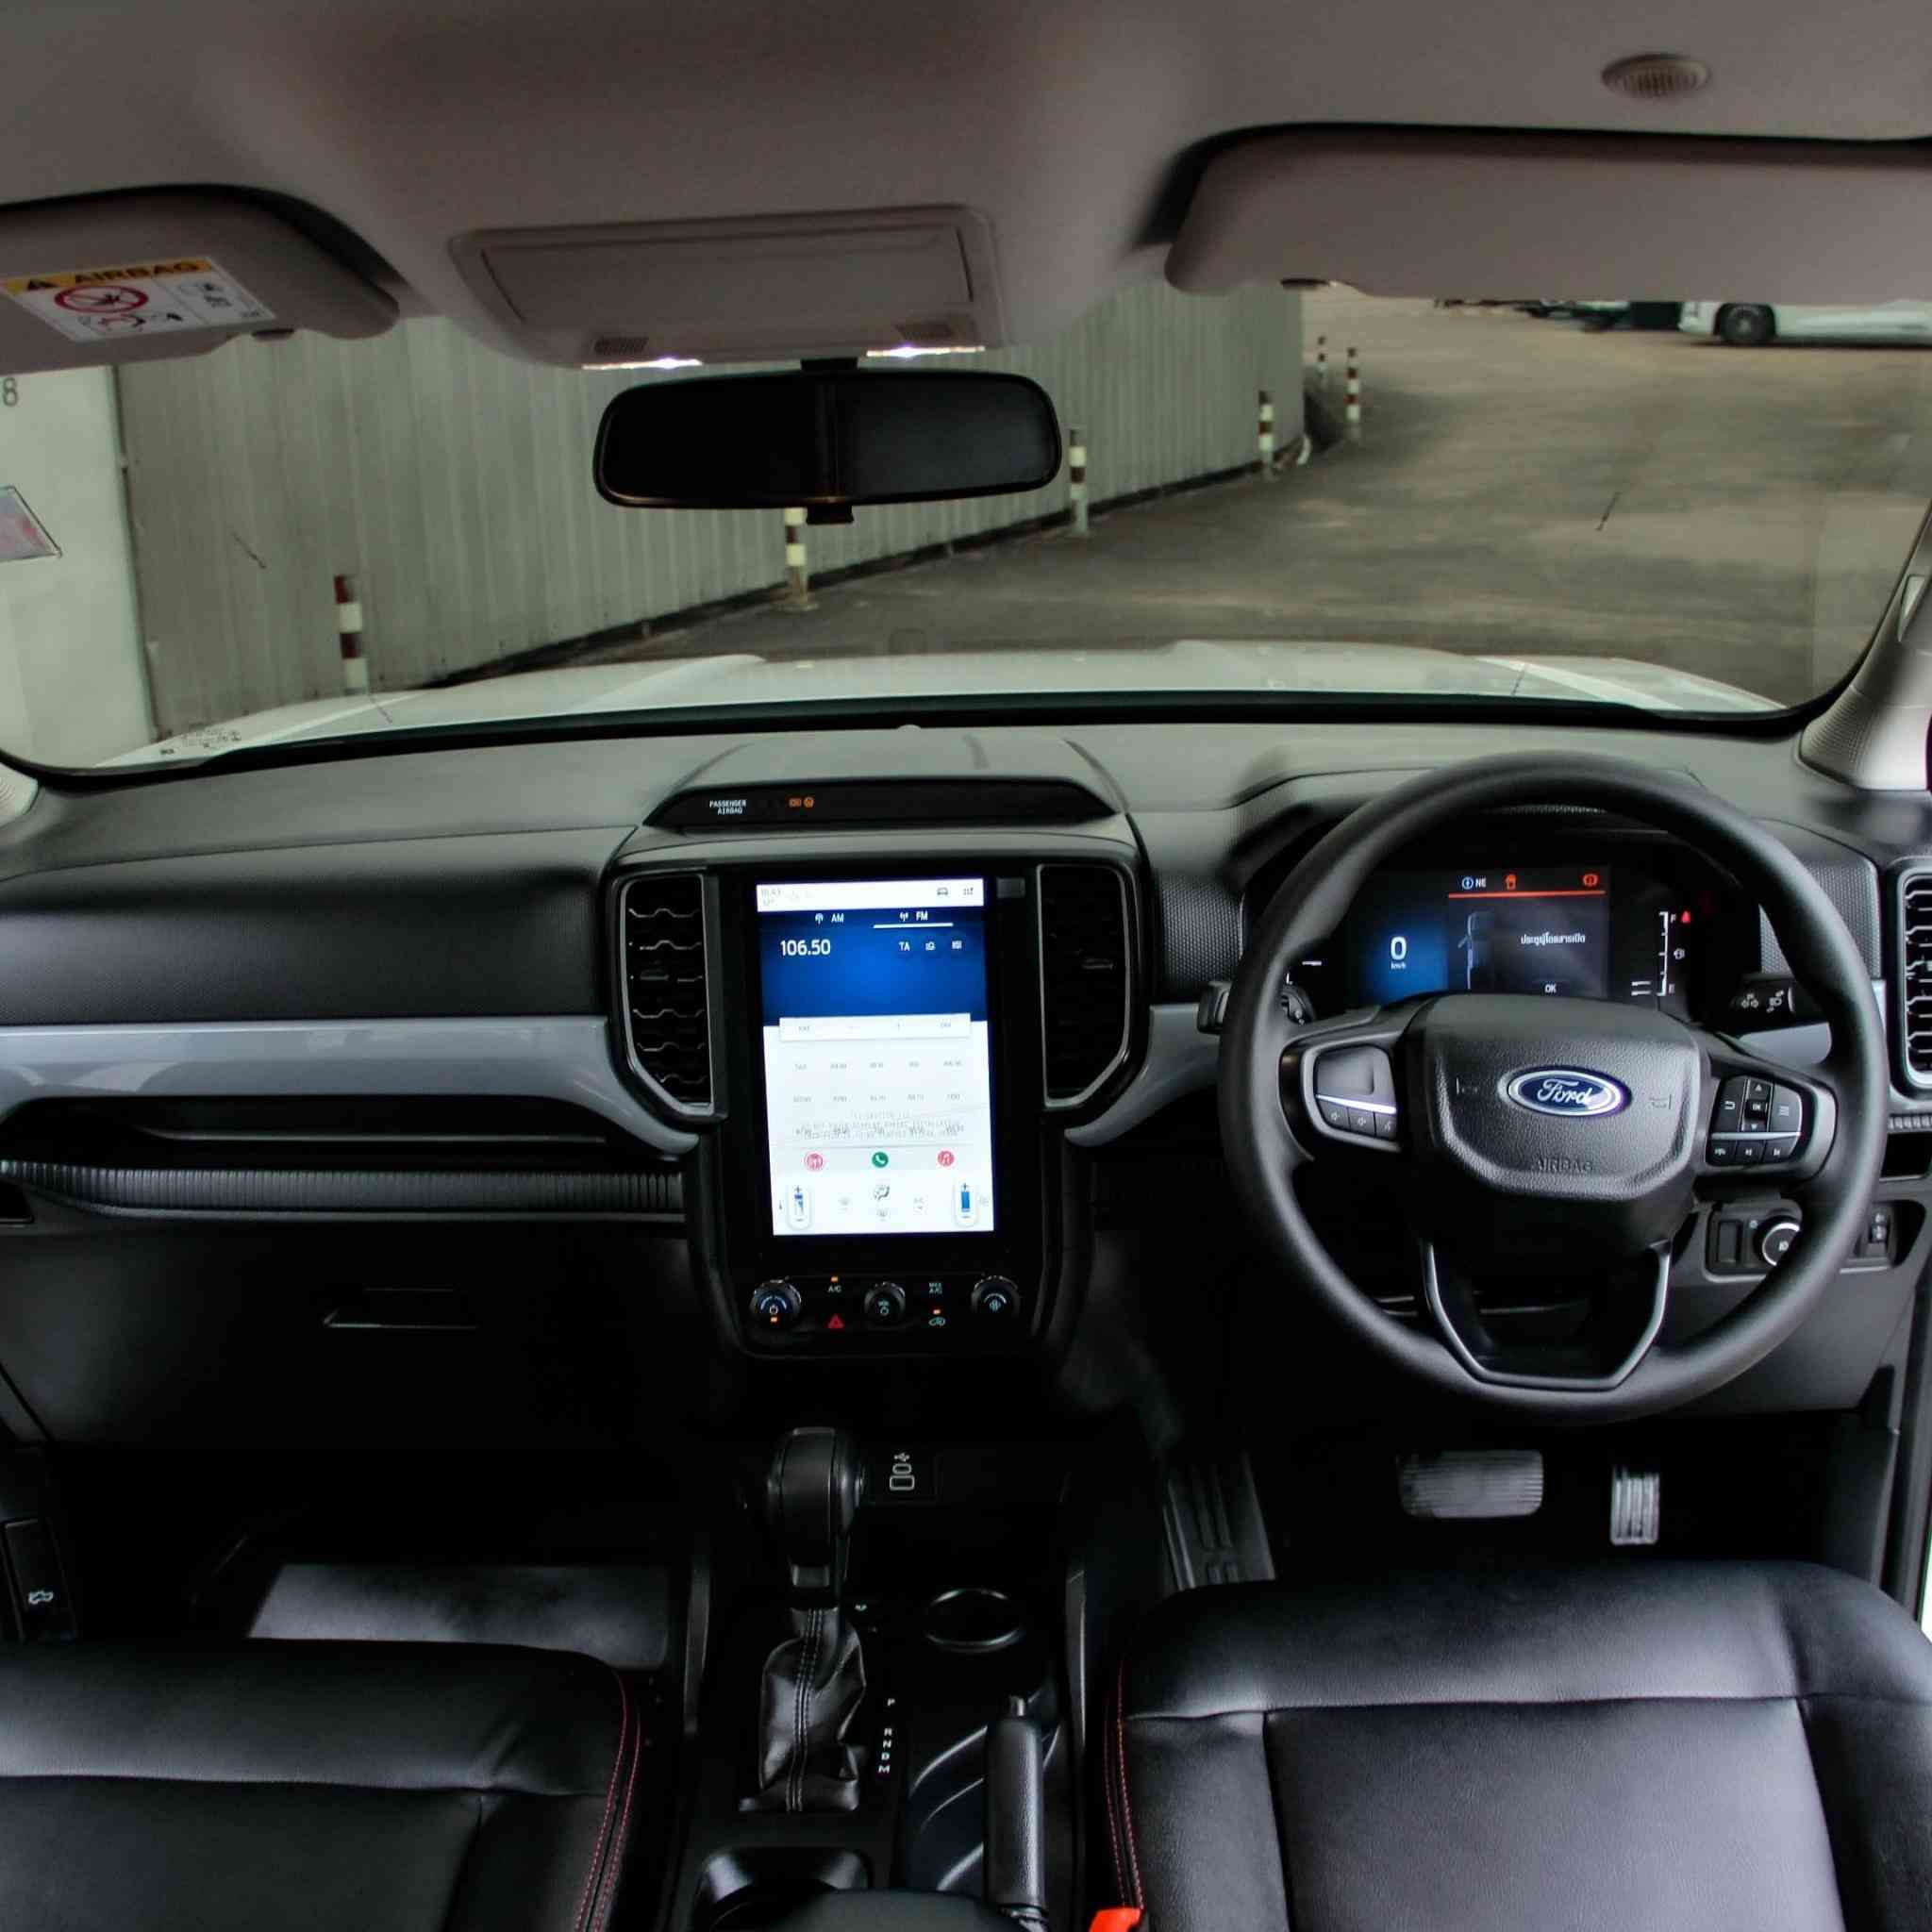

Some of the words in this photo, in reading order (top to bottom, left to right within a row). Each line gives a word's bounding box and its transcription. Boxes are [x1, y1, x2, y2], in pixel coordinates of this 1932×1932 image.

[75, 260, 199, 283] AIRBAG
[709, 799, 746, 808] PASSENGER
[717, 807, 743, 815] AIRBAG
[831, 913, 844, 923] AM
[916, 911, 928, 921] FM
[780, 939, 831, 957] 106.50
[899, 941, 910, 951] TA
[1391, 936, 1407, 960] 0
[1544, 984, 1557, 993] OK
[1537, 1077, 1592, 1105] Ford
[1534, 1158, 1593, 1172] AIRBAG
[827, 1285, 841, 1293] A/C
[881, 1752, 890, 1760] D
[878, 1765, 891, 1774] M
